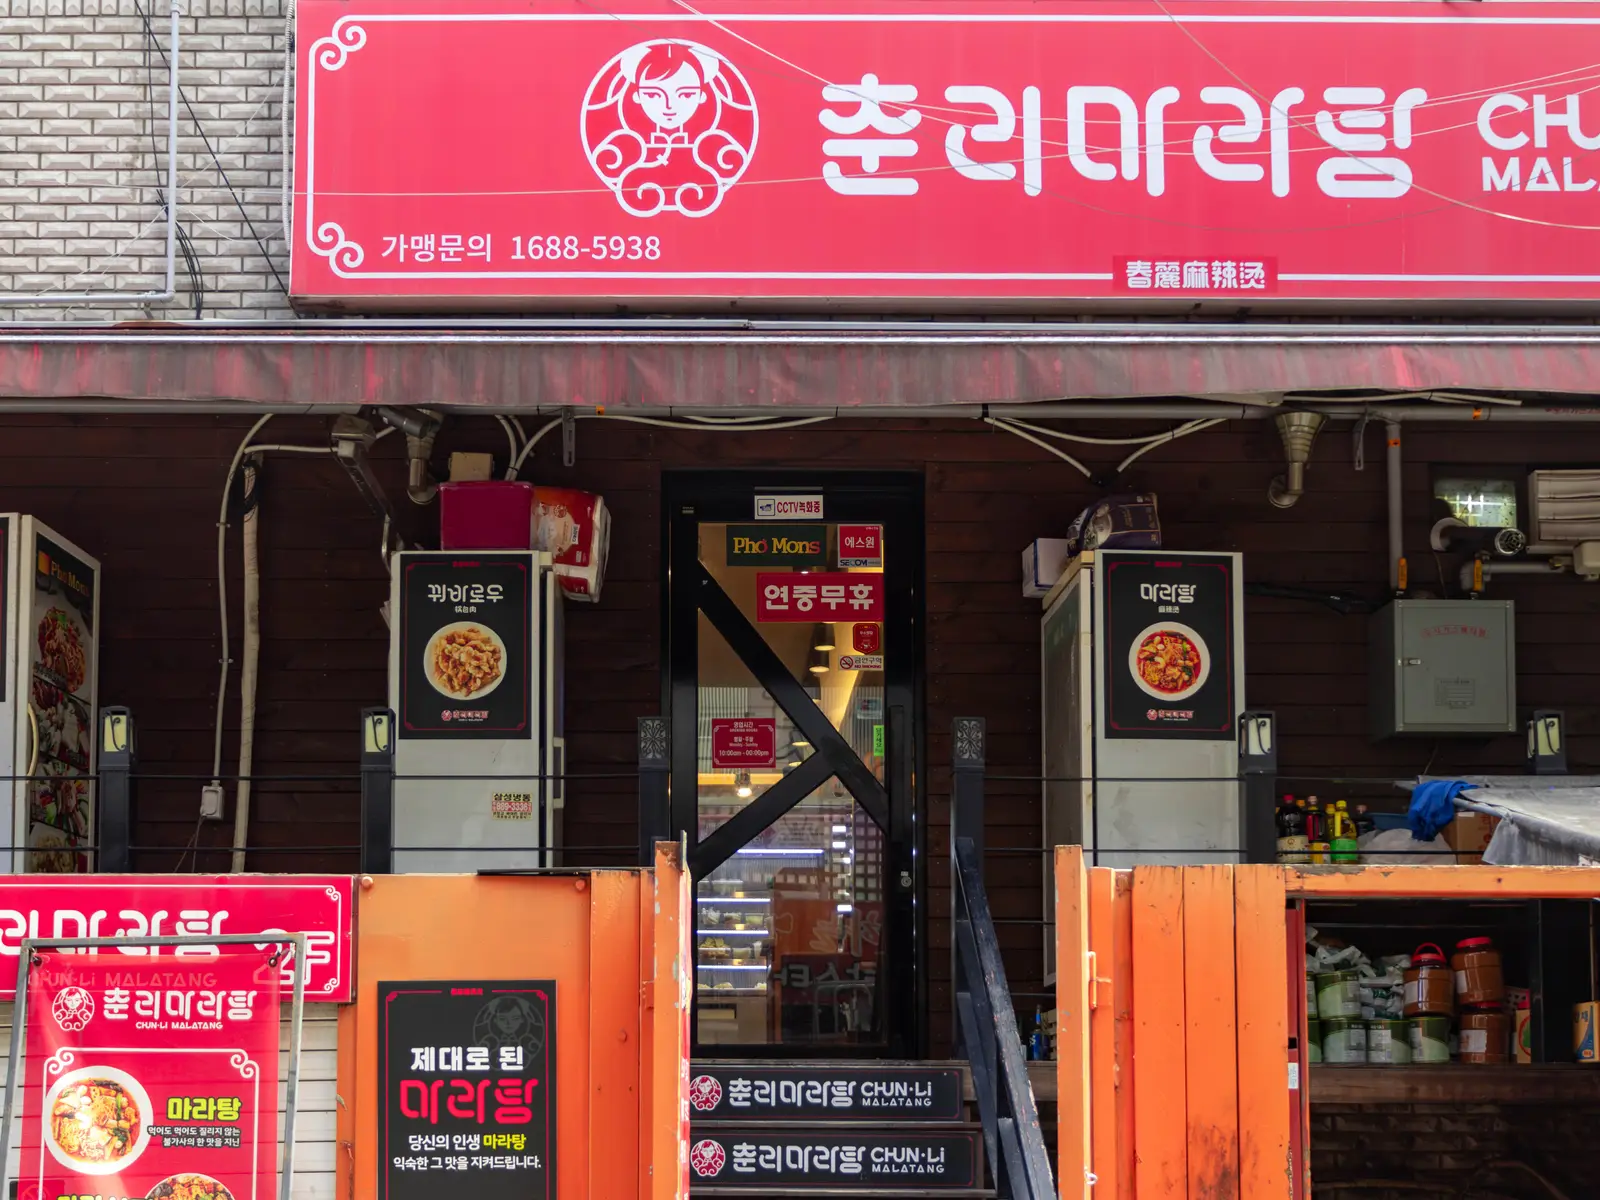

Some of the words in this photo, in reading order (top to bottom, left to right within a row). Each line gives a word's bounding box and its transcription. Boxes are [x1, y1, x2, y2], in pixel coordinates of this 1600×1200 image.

[818, 73, 1428, 198] 춘리마라탕
[1482, 156, 1600, 192] MAL
[381, 234, 492, 262] 가맹문의
[511, 235, 661, 261] 1688-5938
[776, 501, 821, 513] CCTV녹화중
[771, 537, 821, 554] Mons
[844, 536, 875, 549] 에스원
[840, 559, 868, 567] SECOM
[427, 584, 504, 603] 꿔바로우
[764, 584, 874, 612] 연중무휴
[1140, 583, 1197, 603] 마라탕
[854, 657, 882, 665] 금연구역
[105, 972, 218, 987] MALATANG
[103, 987, 258, 1020] 춘리마라탕
[171, 1022, 223, 1030] MALATANG
[411, 1046, 490, 1071] 제대로
[499, 1046, 524, 1070] 된
[728, 1077, 856, 1107] 춘리마라탕
[167, 1097, 242, 1121] 마라탕
[400, 1079, 539, 1125] 마라탕
[862, 1098, 932, 1107] MALATANG
[174, 1126, 198, 1136] 먹어도
[200, 1127, 223, 1136] 질리지
[224, 1127, 241, 1136] 않는
[163, 1137, 195, 1147] 불가사의
[197, 1137, 205, 1147] 한
[206, 1137, 222, 1147] 맛을
[224, 1138, 240, 1147] 지닌
[408, 1134, 450, 1151] 당신의
[452, 1134, 480, 1150] 인생
[483, 1133, 527, 1150] 마라탕
[393, 1156, 428, 1170] 익숙한
[430, 1157, 443, 1168] 그
[445, 1156, 469, 1170] 맛을
[470, 1155, 542, 1169] 지켜드립니다.
[732, 1142, 866, 1174] 춘리마라탕
[872, 1164, 945, 1173] MALATANG
